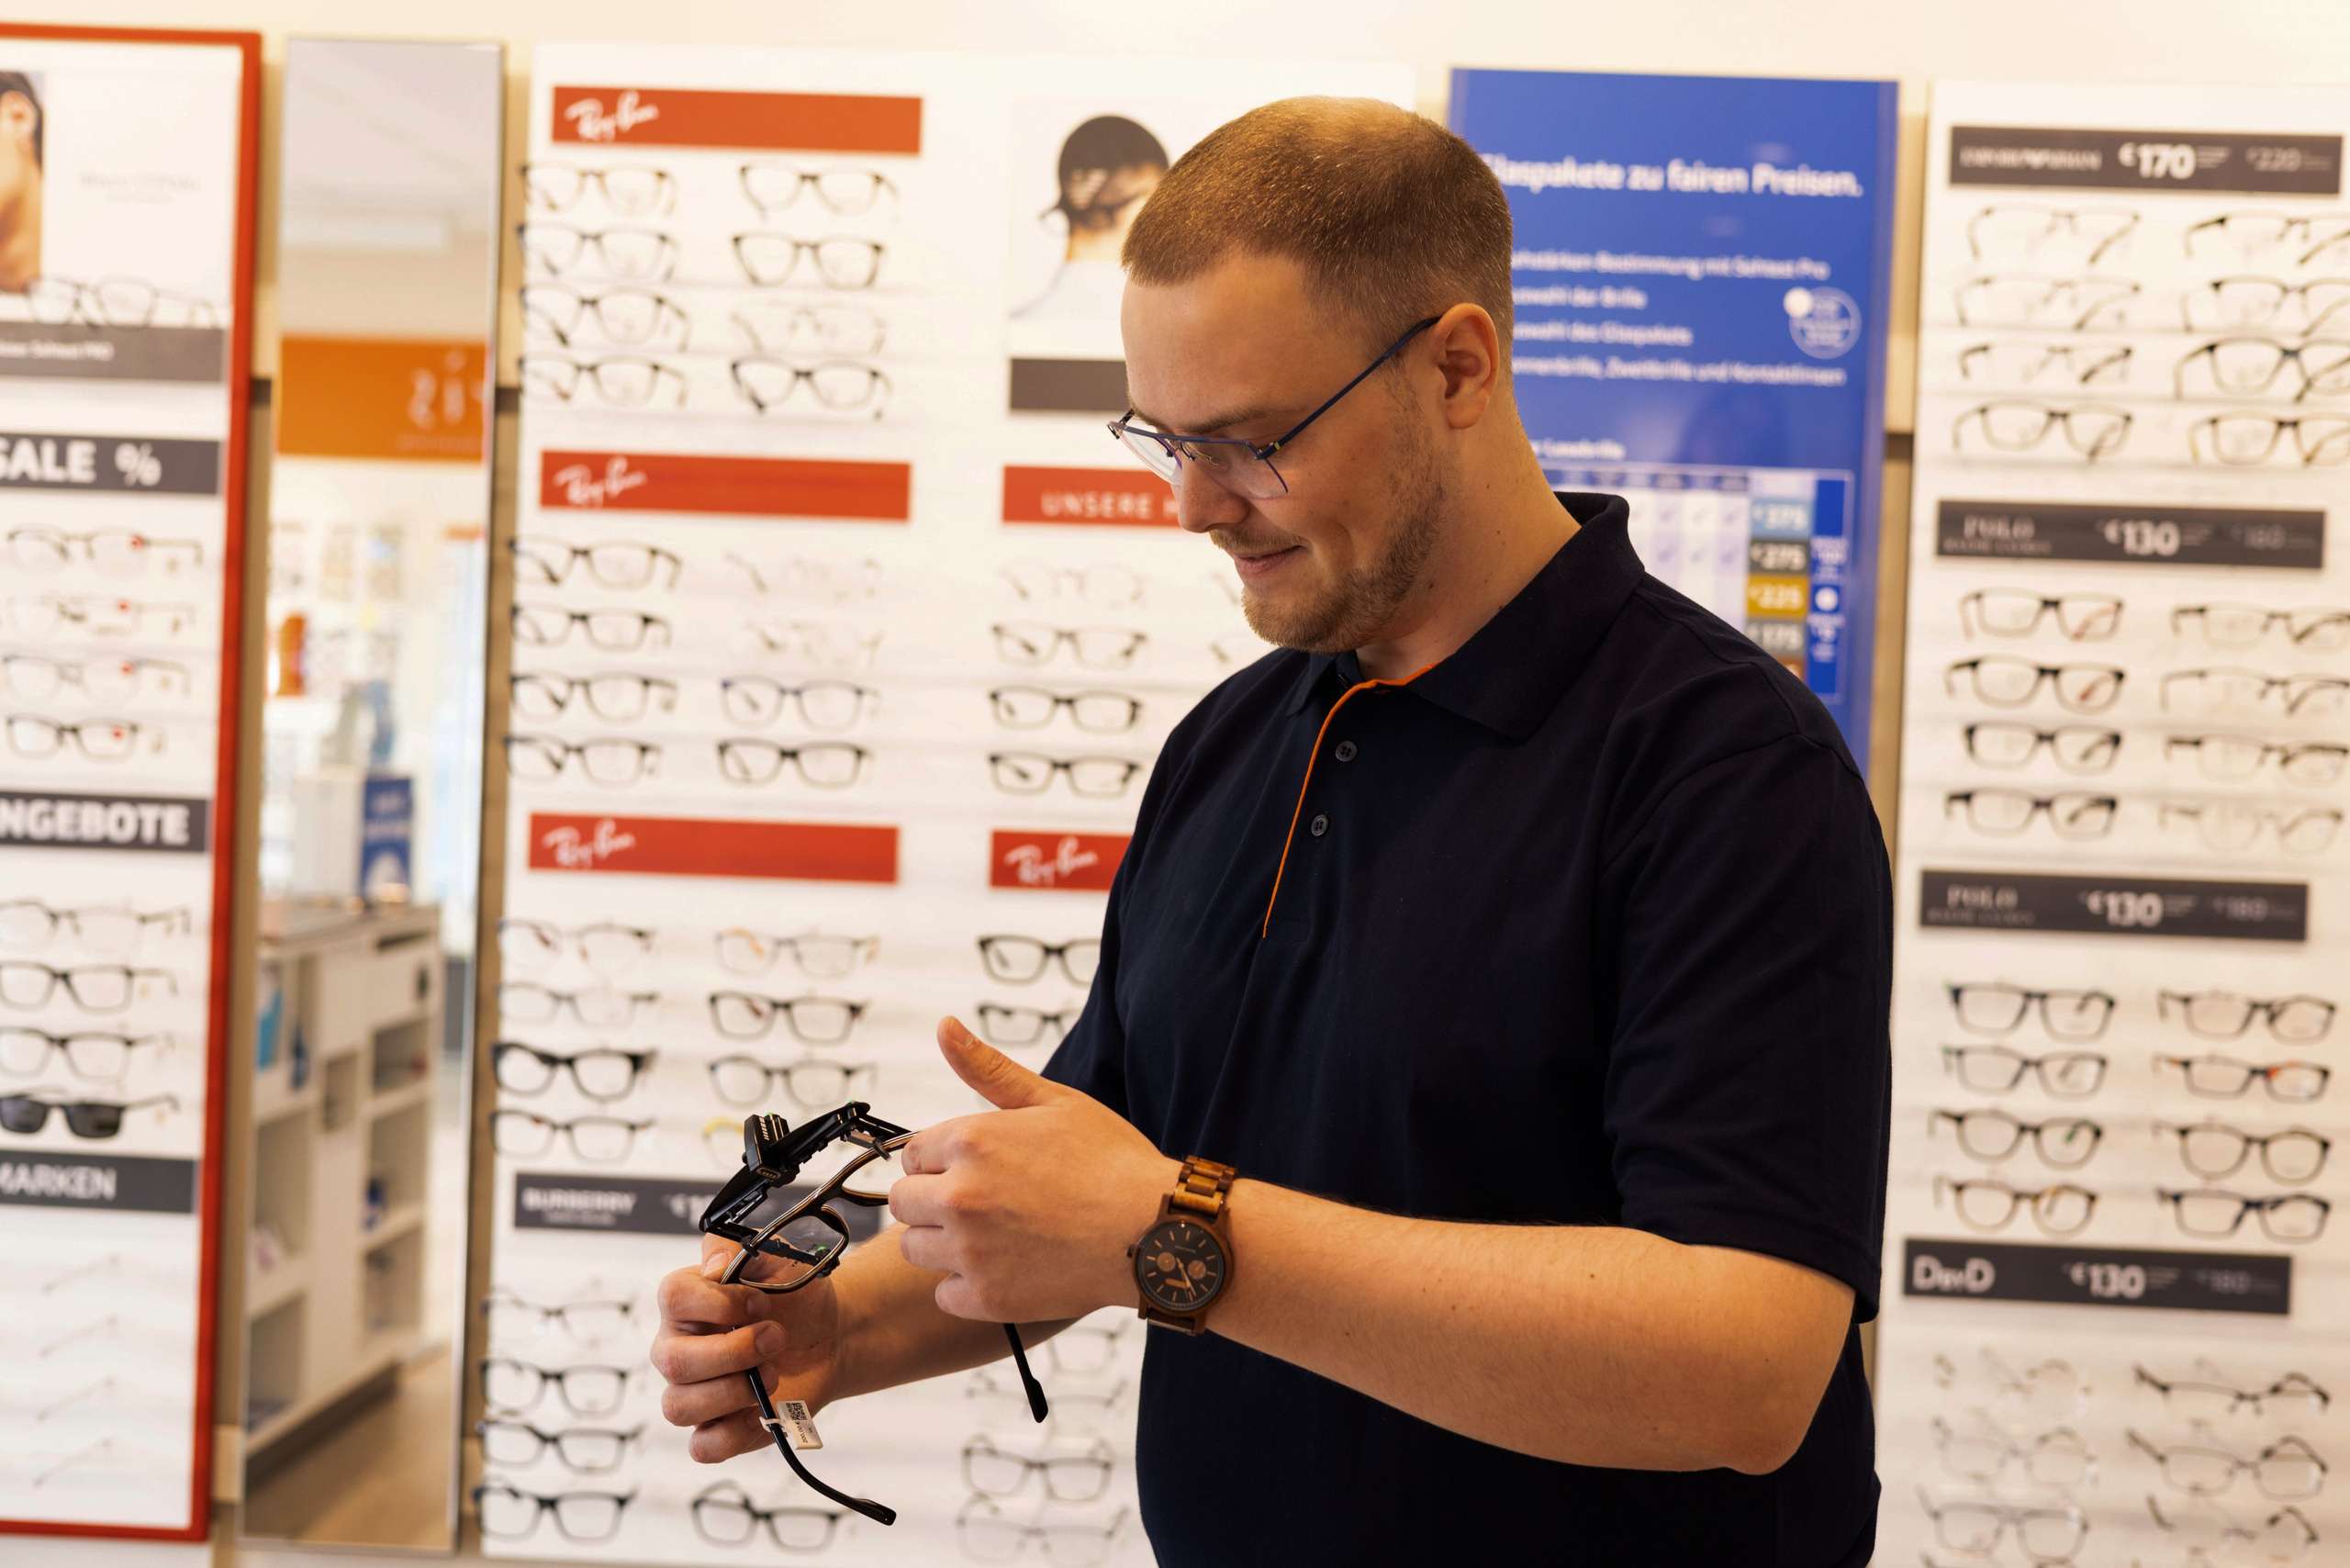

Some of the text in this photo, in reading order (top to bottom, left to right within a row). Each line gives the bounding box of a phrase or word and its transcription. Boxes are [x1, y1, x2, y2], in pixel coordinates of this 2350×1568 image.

[1627, 164, 1664, 191] zu
[1667, 158, 1749, 194] fairen
[1751, 162, 1864, 198] Preisen.
[2117, 141, 2198, 180] €170
